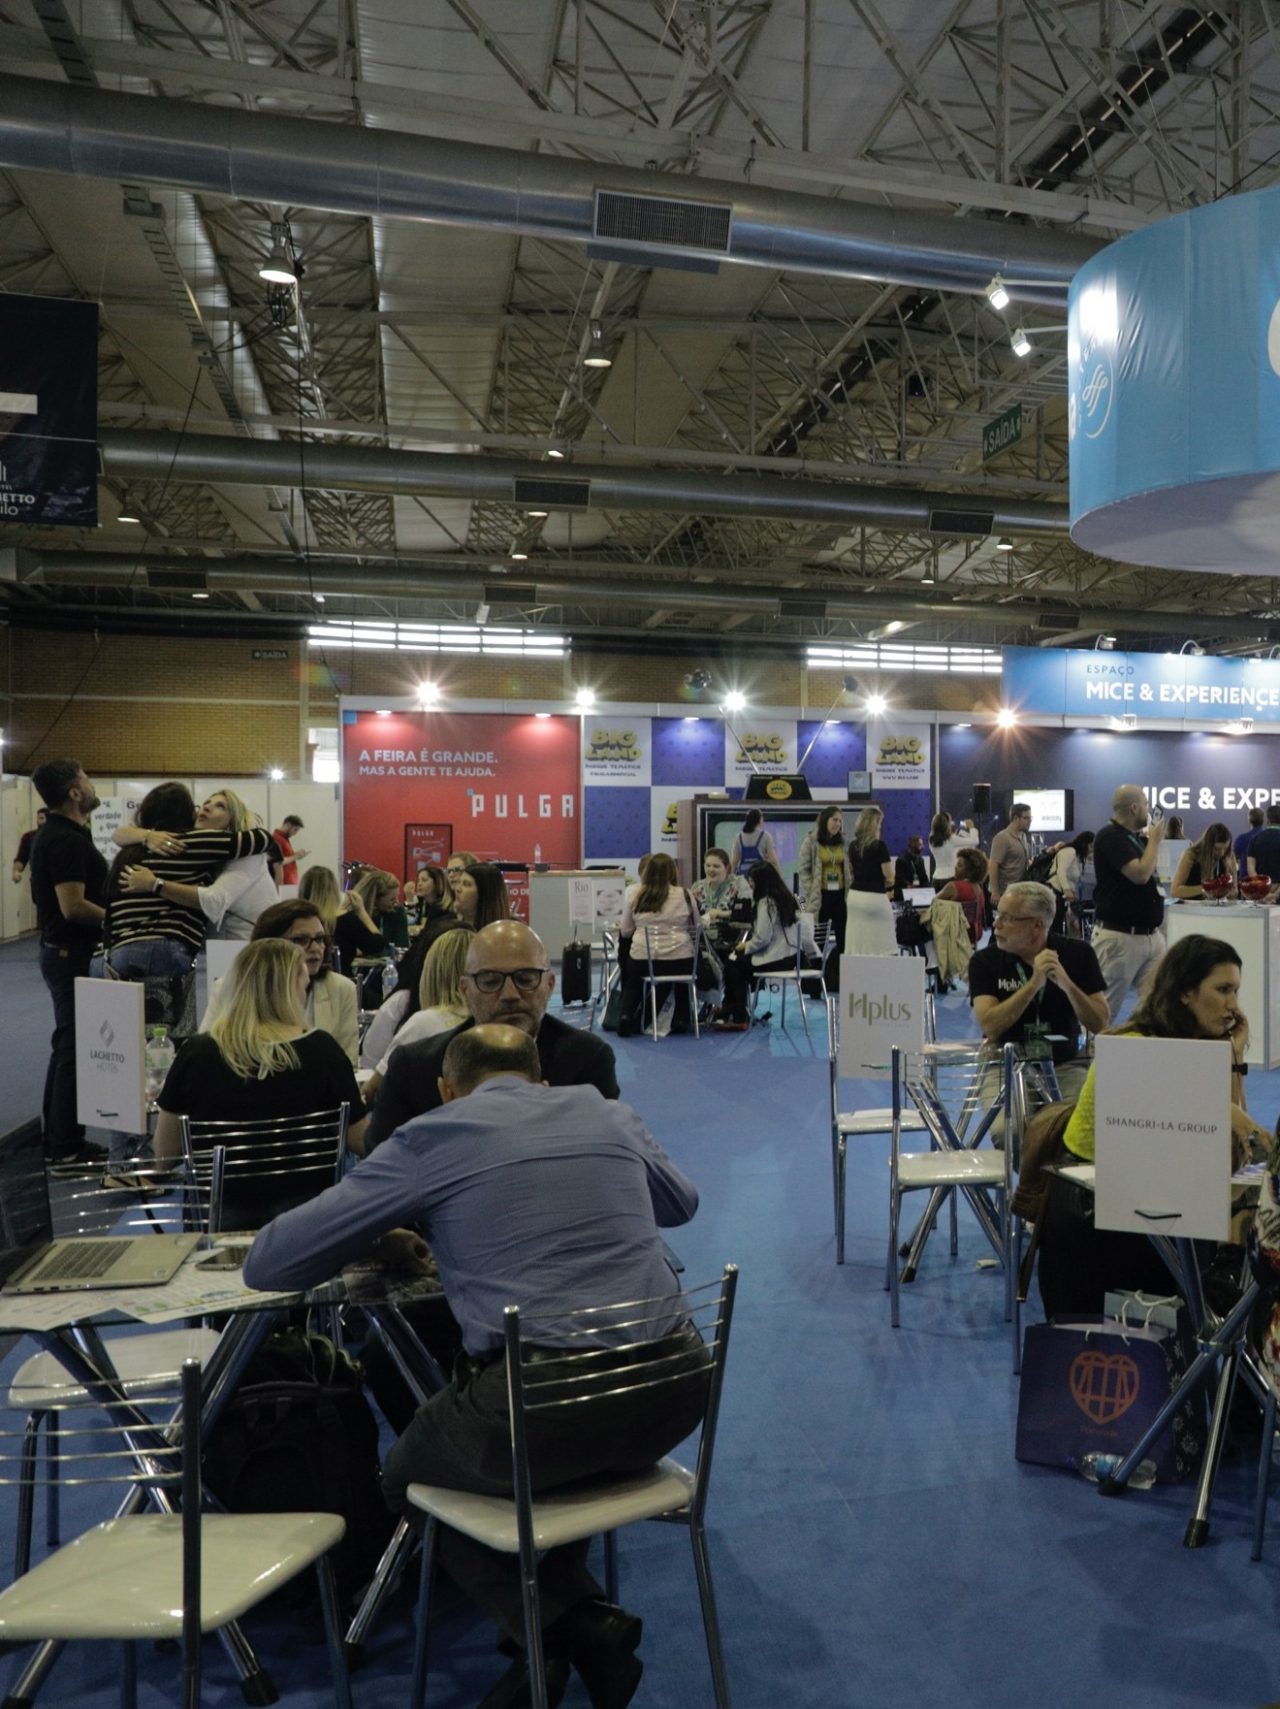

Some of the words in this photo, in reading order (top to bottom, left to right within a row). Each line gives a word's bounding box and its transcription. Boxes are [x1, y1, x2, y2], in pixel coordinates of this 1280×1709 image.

[1086, 665, 1135, 676] ESPAÇO
[1086, 681, 1135, 701] MICE
[1139, 684, 1154, 701] &
[1159, 684, 1280, 706] EXPERIENCE
[590, 729, 638, 749] BIG
[742, 732, 784, 751] BIG
[880, 735, 922, 753] BIG
[359, 750, 370, 761] A
[374, 750, 416, 762] FEIRA
[420, 747, 428, 762] É
[432, 751, 498, 763] GRANDE.
[585, 746, 643, 761] LAND
[876, 750, 926, 766] LAND
[359, 765, 384, 776] MAS
[387, 766, 396, 776] A
[399, 766, 436, 776] GENTE
[439, 767, 452, 776] TE
[455, 767, 496, 777] AJUDA.
[472, 794, 574, 818] PULGA
[1199, 787, 1216, 809] &
[574, 880, 589, 893] Rio
[849, 992, 912, 1026] Hplus
[90, 1049, 125, 1064] LAGHETTO
[1177, 1122, 1218, 1134] GROUP
